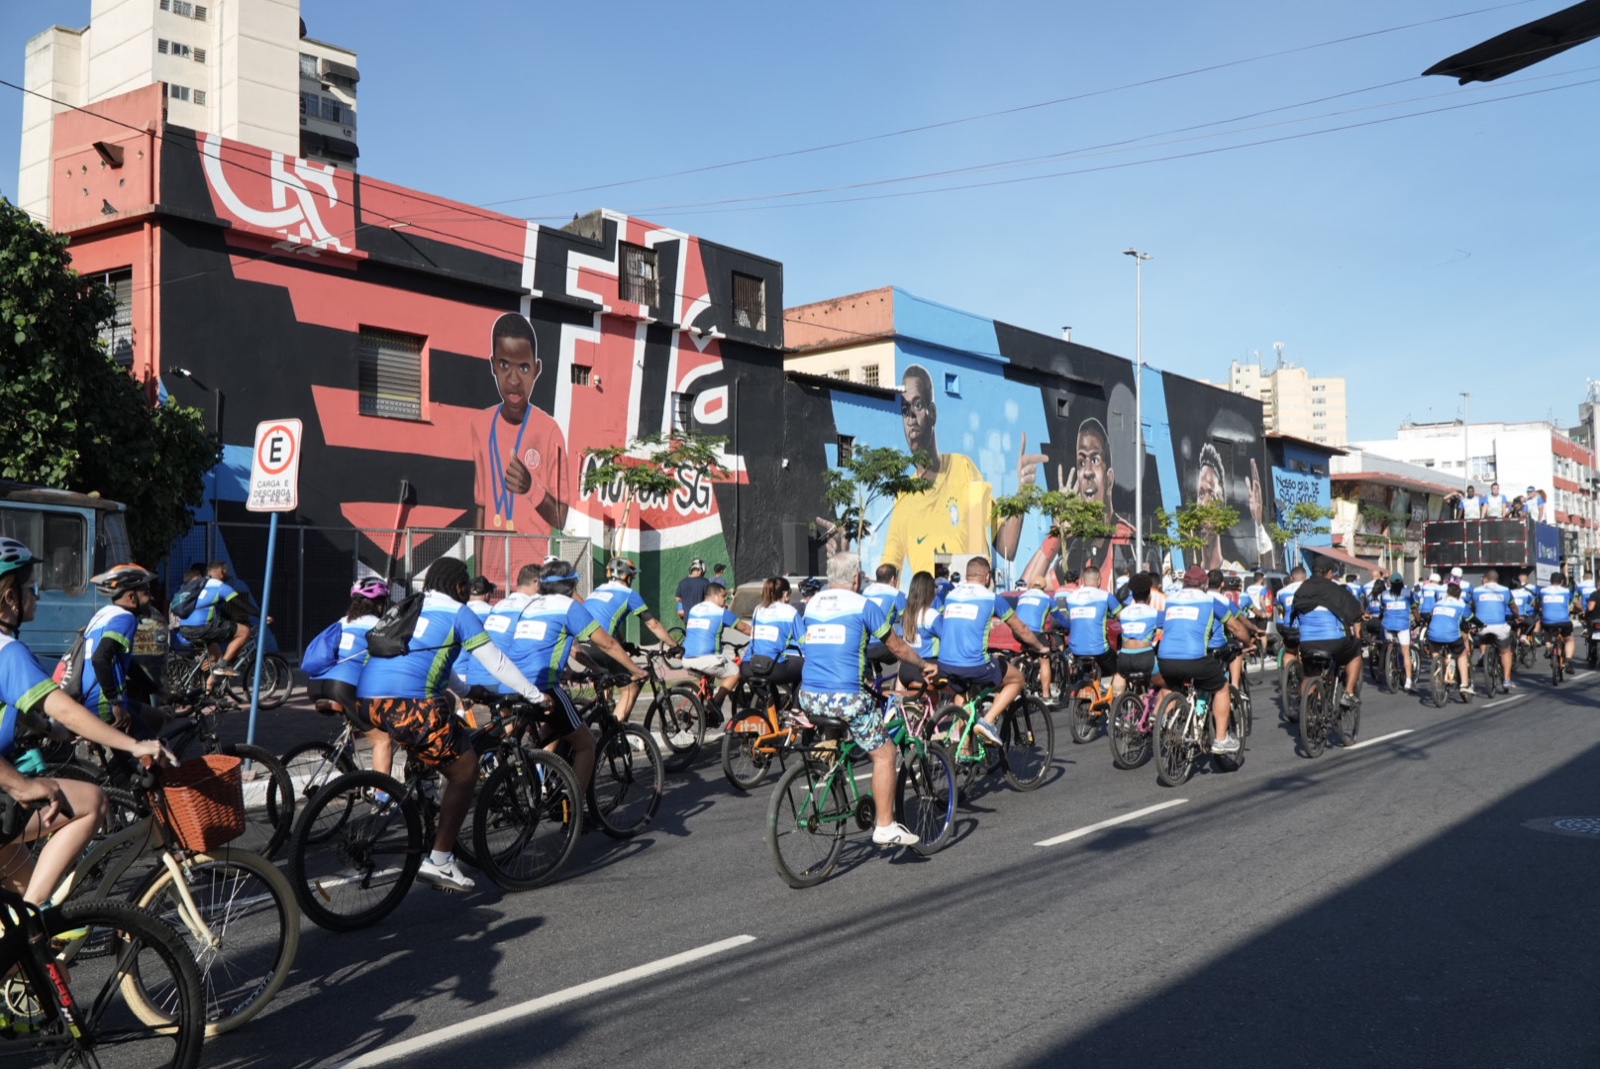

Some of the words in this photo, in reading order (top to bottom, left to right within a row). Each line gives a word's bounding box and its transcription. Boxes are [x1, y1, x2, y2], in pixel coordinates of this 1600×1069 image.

[269, 437, 283, 463] E
[256, 480, 280, 489] CARGA
[284, 479, 289, 487] E
[674, 462, 713, 514] SG
[253, 489, 291, 498] DESCARGA
[740, 718, 767, 736] itaú
